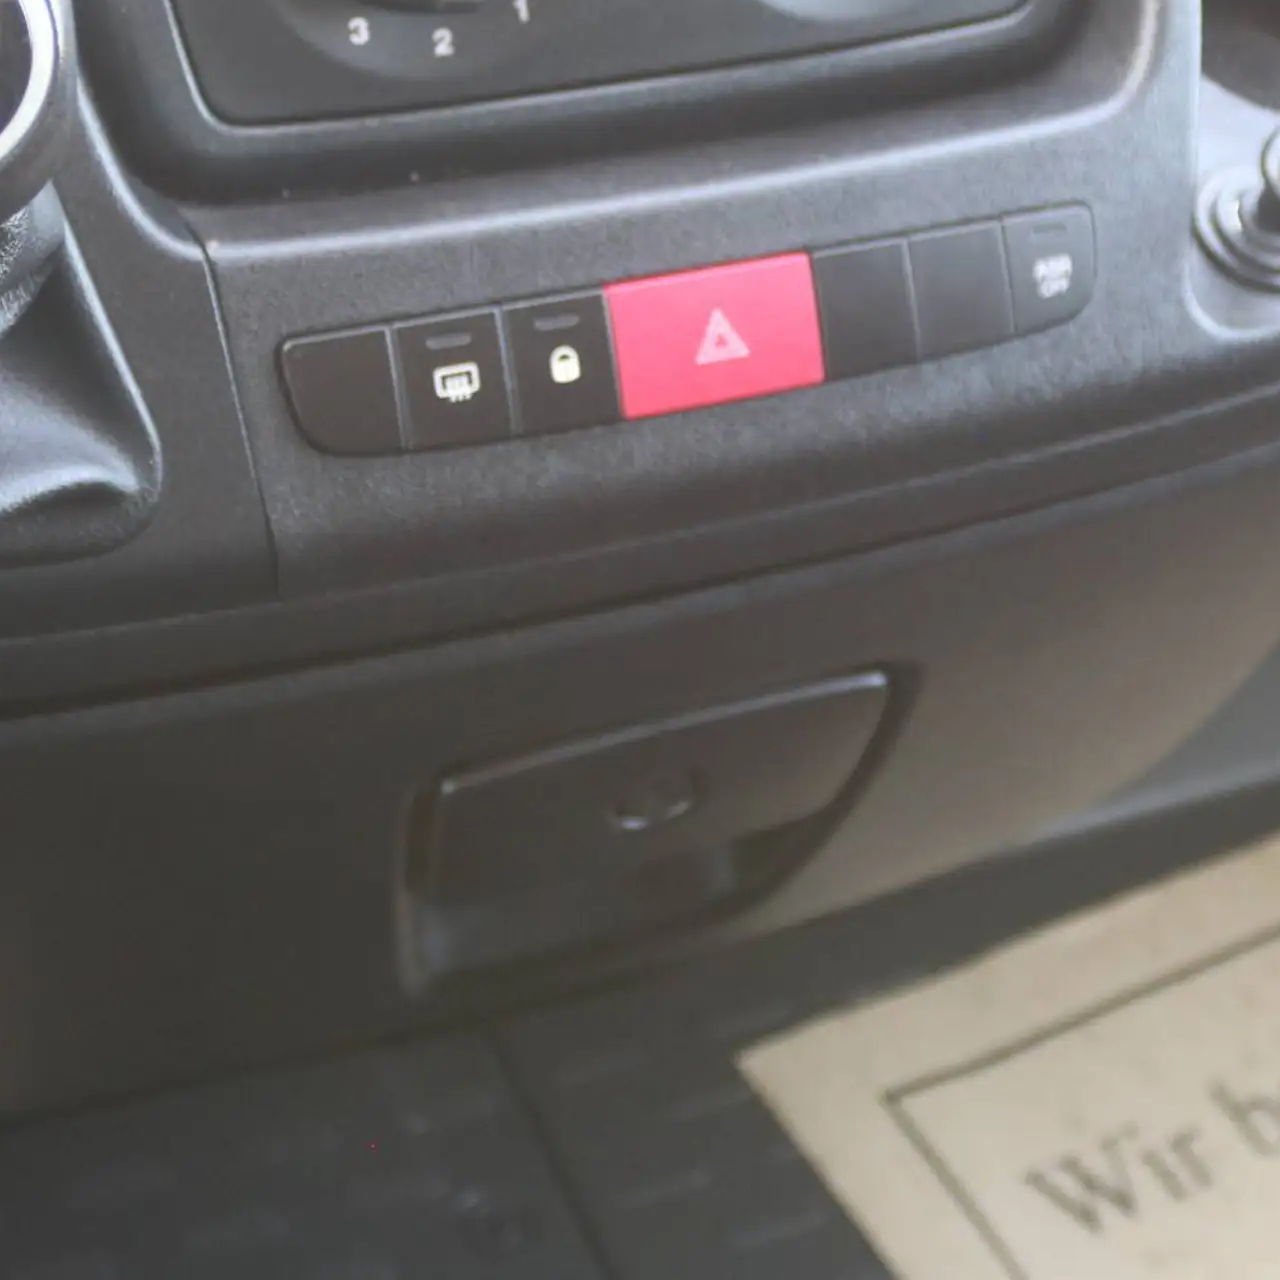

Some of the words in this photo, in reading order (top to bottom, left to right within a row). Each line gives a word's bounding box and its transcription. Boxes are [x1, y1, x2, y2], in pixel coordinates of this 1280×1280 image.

[347, 16, 371, 46] 3
[432, 27, 455, 57] 2
[1023, 1122, 1213, 1234] Wir
